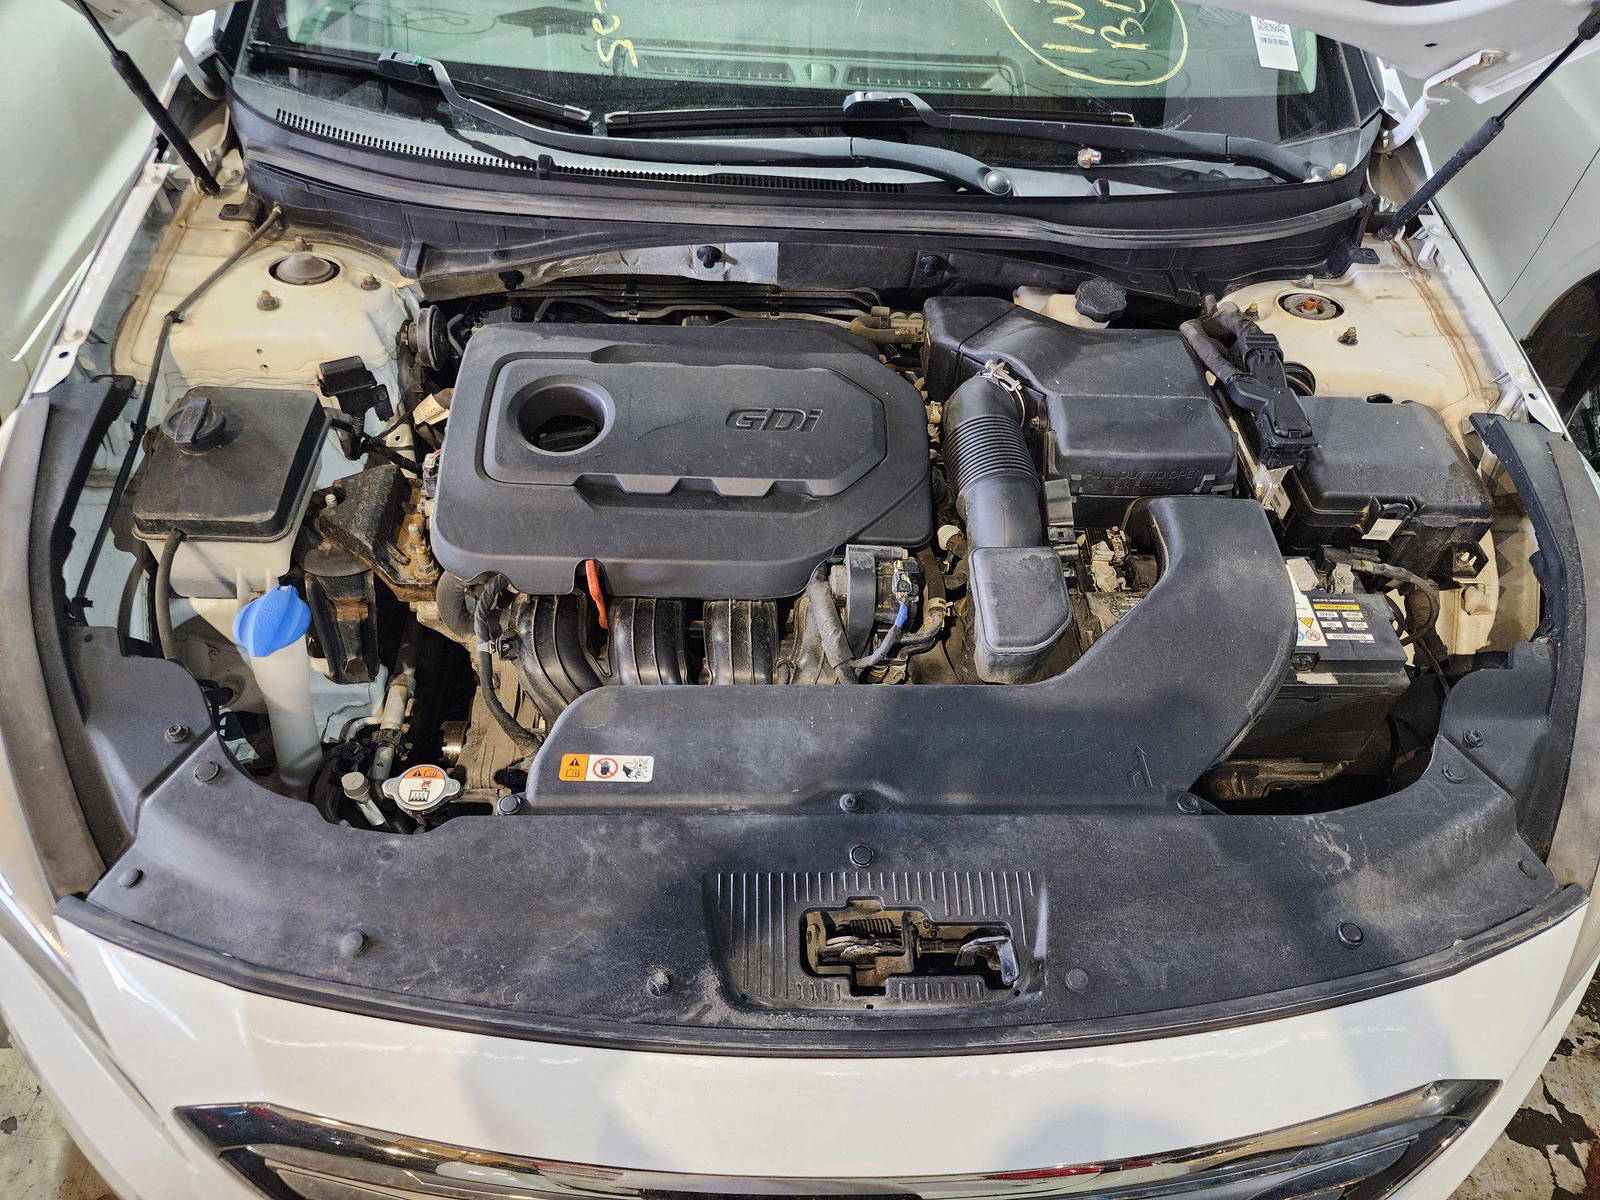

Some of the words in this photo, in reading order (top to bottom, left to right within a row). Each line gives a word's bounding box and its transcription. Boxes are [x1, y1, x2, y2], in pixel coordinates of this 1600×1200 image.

[726, 406, 823, 433] GDi
[1120, 470, 1145, 480] OUT
[1150, 470, 1167, 480] TO
[1168, 469, 1204, 481] OPEN
